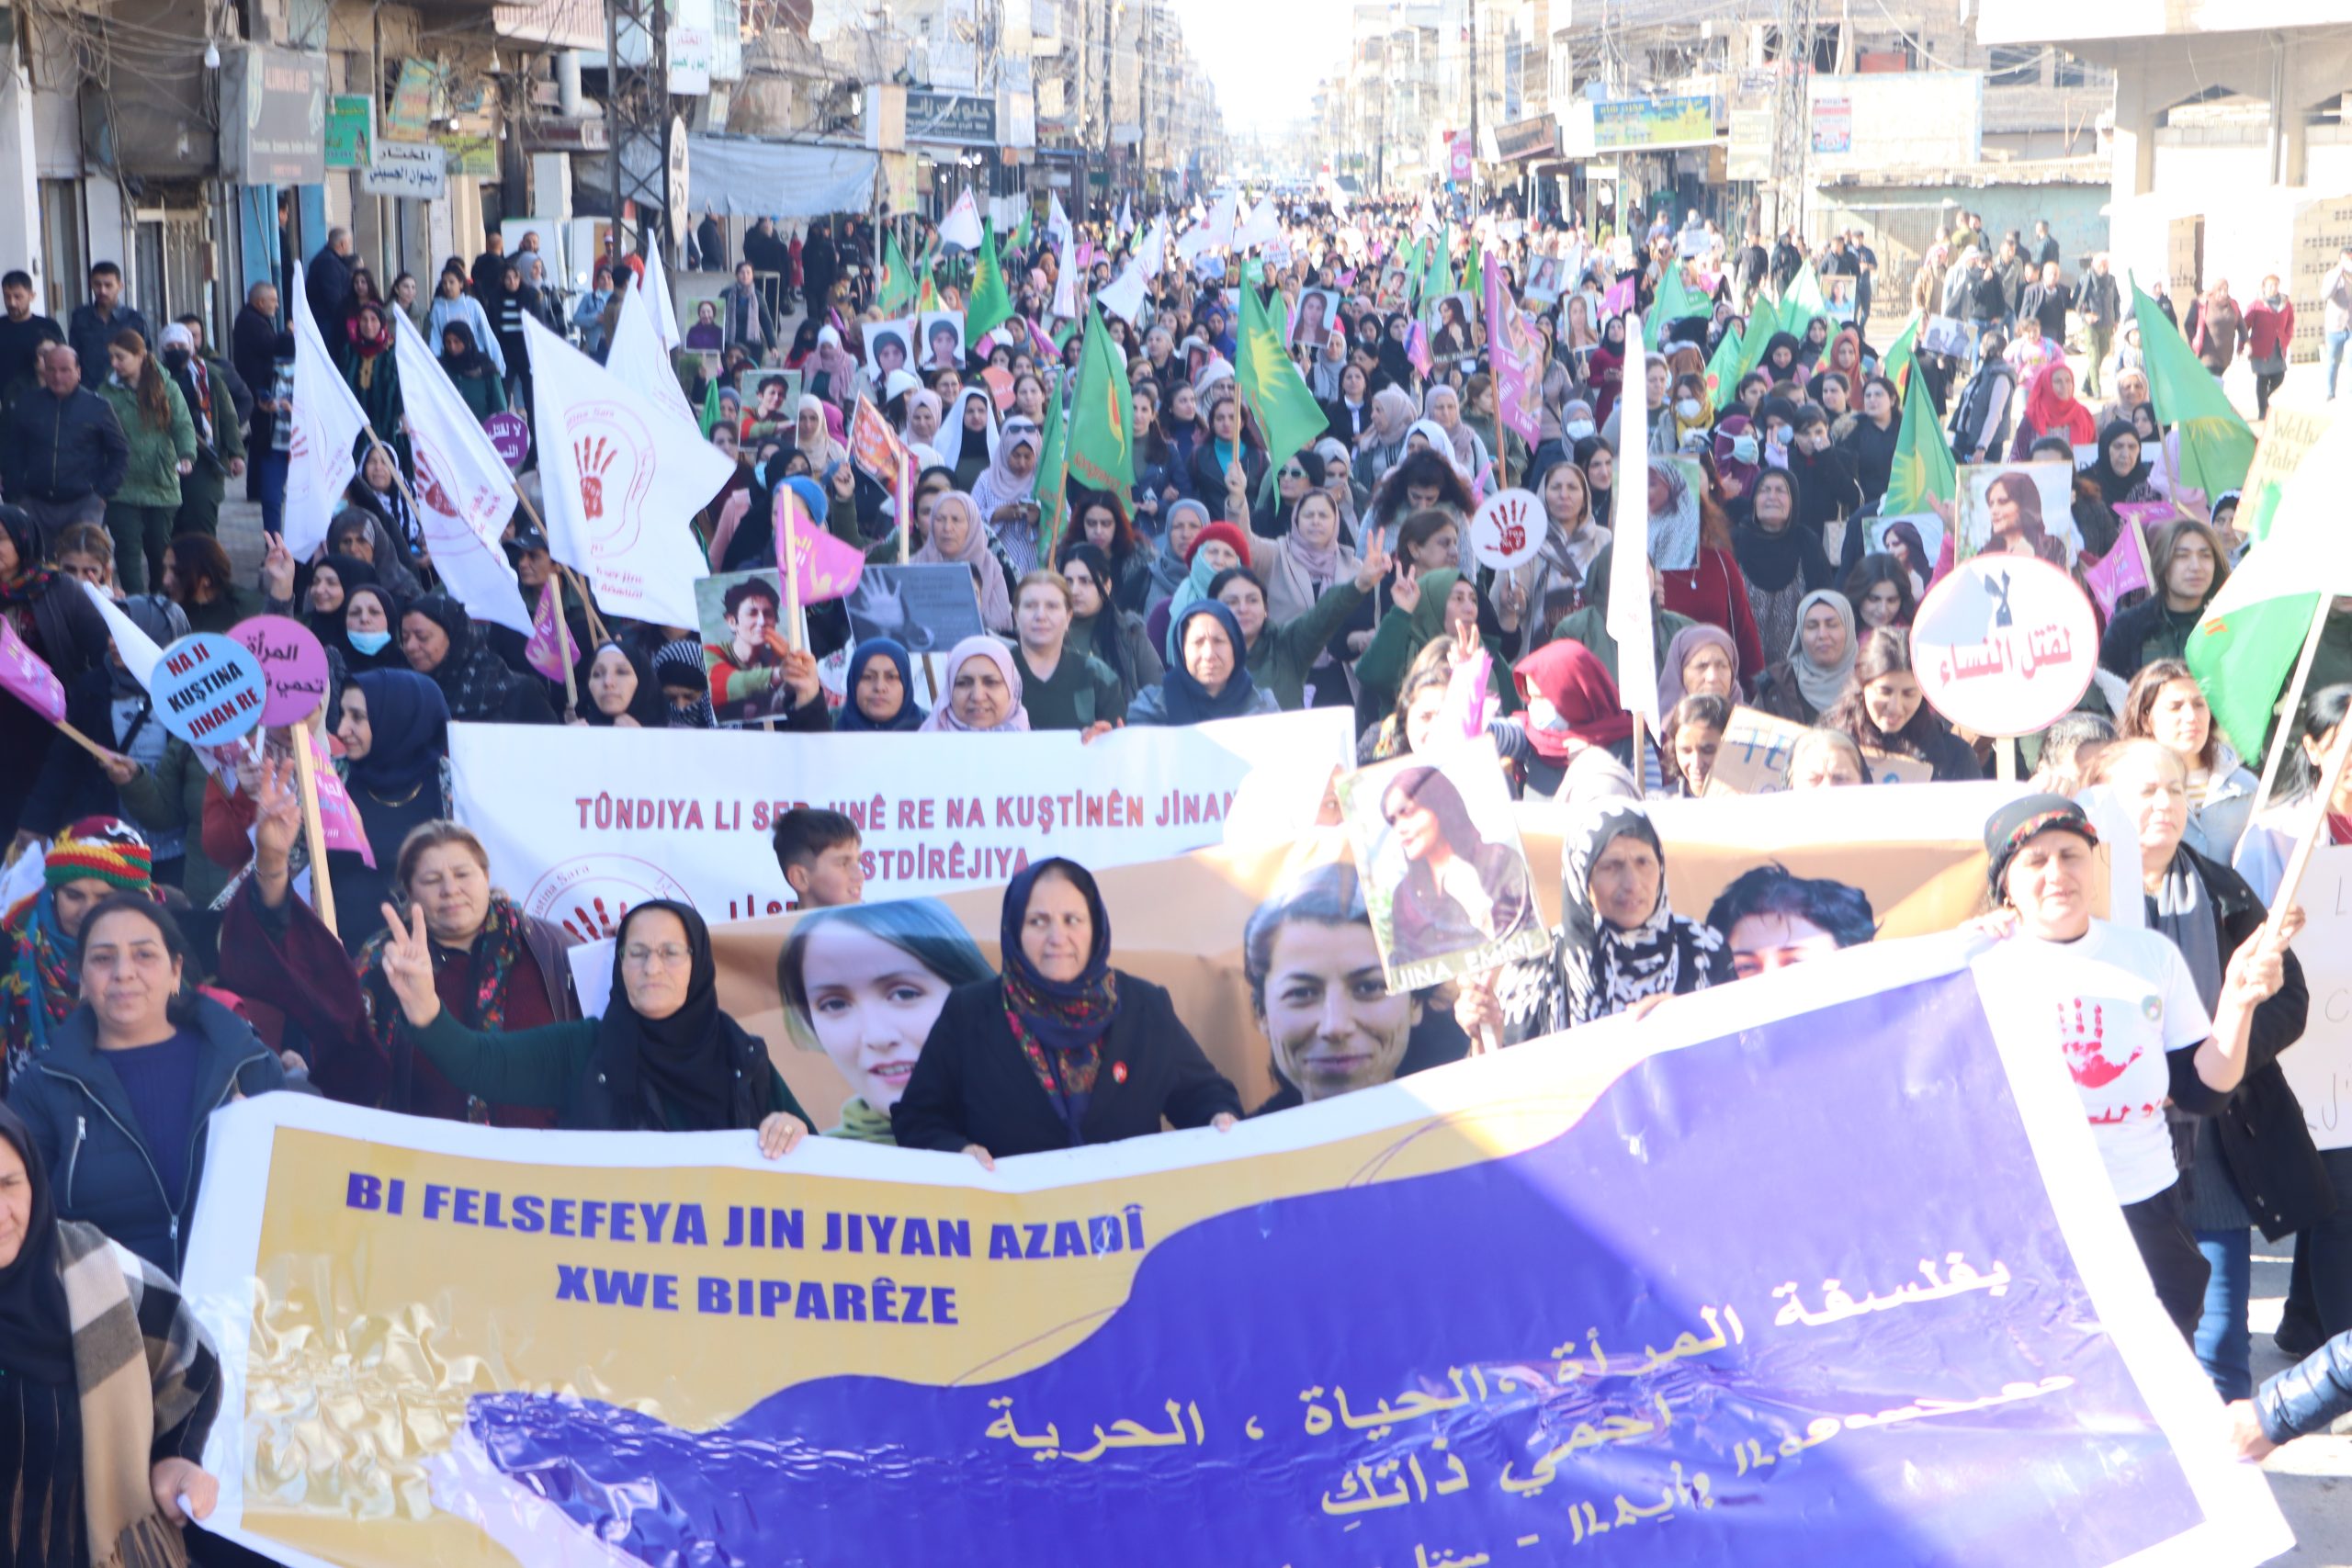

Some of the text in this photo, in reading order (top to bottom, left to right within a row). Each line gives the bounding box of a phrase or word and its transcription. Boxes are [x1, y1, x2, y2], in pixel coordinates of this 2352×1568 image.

[1984, 568, 2014, 629] لا
[165, 641, 211, 678] NA JI
[246, 630, 300, 664] المرأة
[1939, 624, 2073, 689] لقتل النساء
[166, 660, 244, 715] KUŞTINA
[187, 685, 262, 740] JINAN RE
[276, 679, 324, 699] تحمي
[575, 790, 705, 830] TÛNDIYA
[715, 800, 741, 831] LI
[752, 800, 810, 831] SE
[828, 792, 887, 831] NÊ
[898, 798, 935, 830] RE
[946, 797, 986, 829] NA
[996, 787, 1145, 835] KUŞTİNÊN
[556, 863, 591, 886] Sara
[860, 840, 1031, 881] STDİRÊJIYA
[1396, 931, 1534, 992] JINA EMINI
[345, 1171, 1148, 1261] BI FELSEFEYA JIN JIYAN AZADÎ
[555, 1262, 960, 1326] XWE BIPARÊZE
[1550, 1303, 1745, 1384] المرأة
[983, 1394, 1206, 1463] الحرية
[1499, 1390, 1673, 1499] احمي
